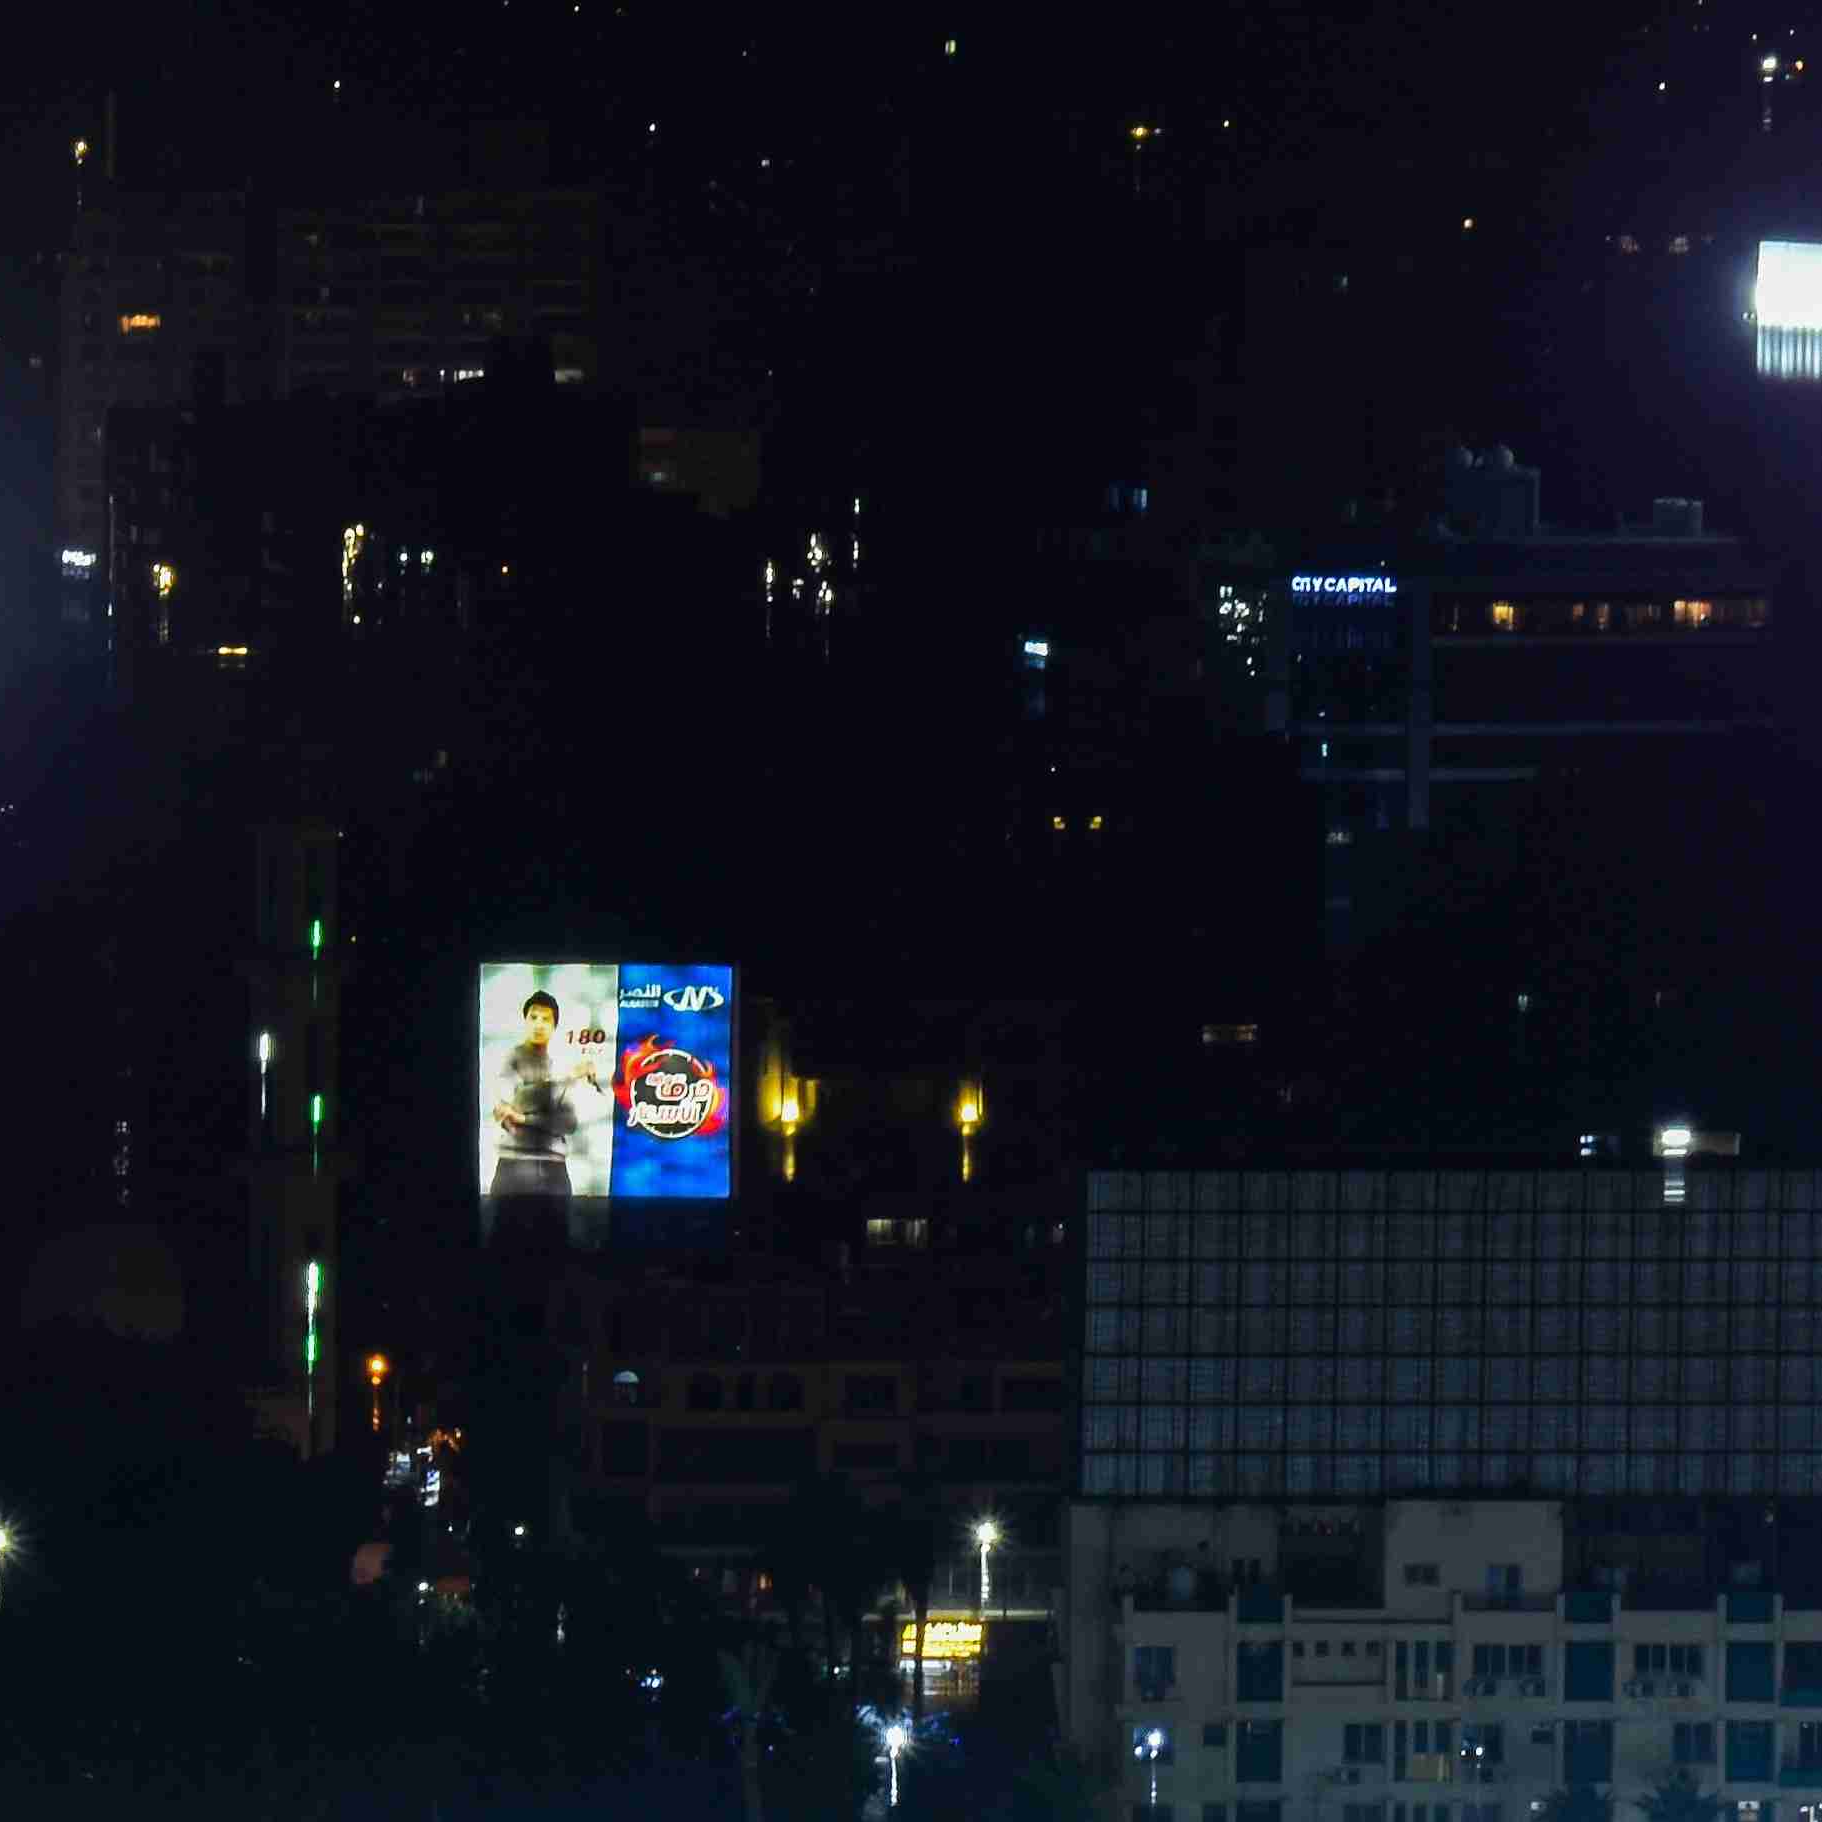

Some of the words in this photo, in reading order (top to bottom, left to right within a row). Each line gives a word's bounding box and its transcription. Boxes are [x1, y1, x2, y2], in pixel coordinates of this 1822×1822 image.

[1291, 575, 1323, 593] CITY
[1323, 575, 1397, 593] CAPITAL
[565, 1028, 607, 1045] 180
